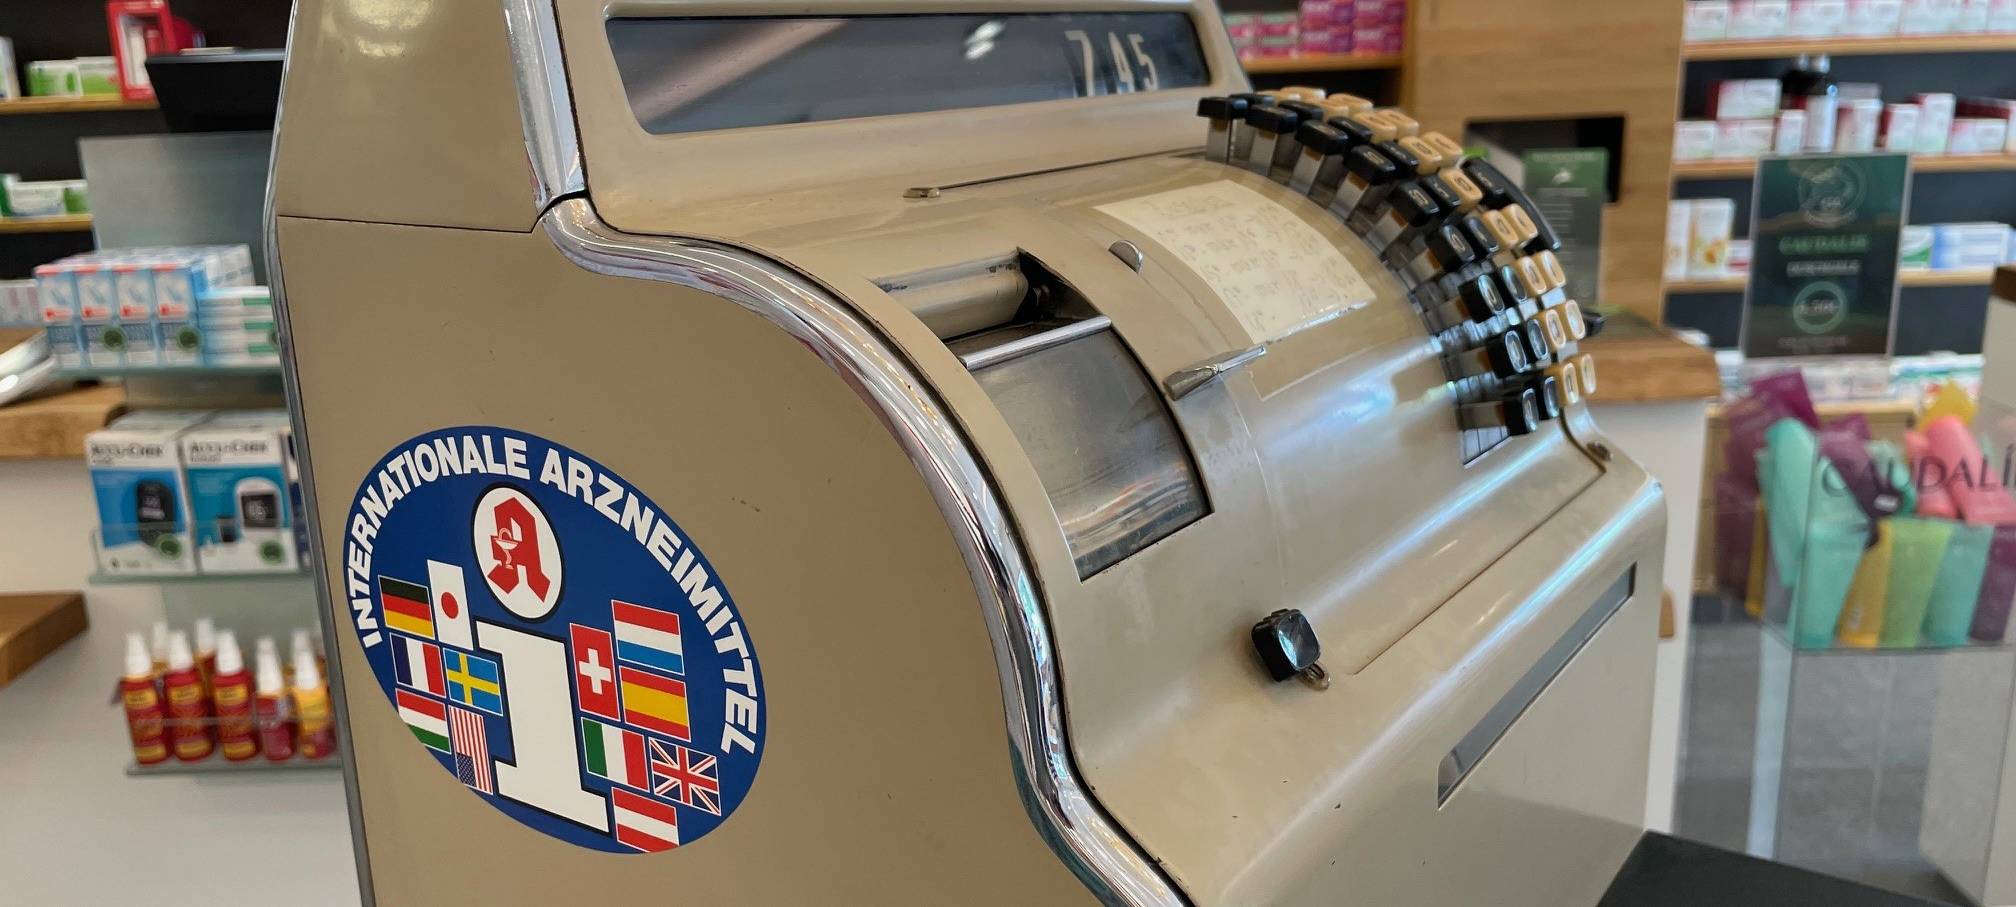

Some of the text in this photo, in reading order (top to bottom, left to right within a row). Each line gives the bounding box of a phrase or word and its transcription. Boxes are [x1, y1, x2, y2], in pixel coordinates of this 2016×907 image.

[348, 434, 758, 755] INTERNATIONALE ARZNEIMITTEL
[487, 496, 551, 603] A
